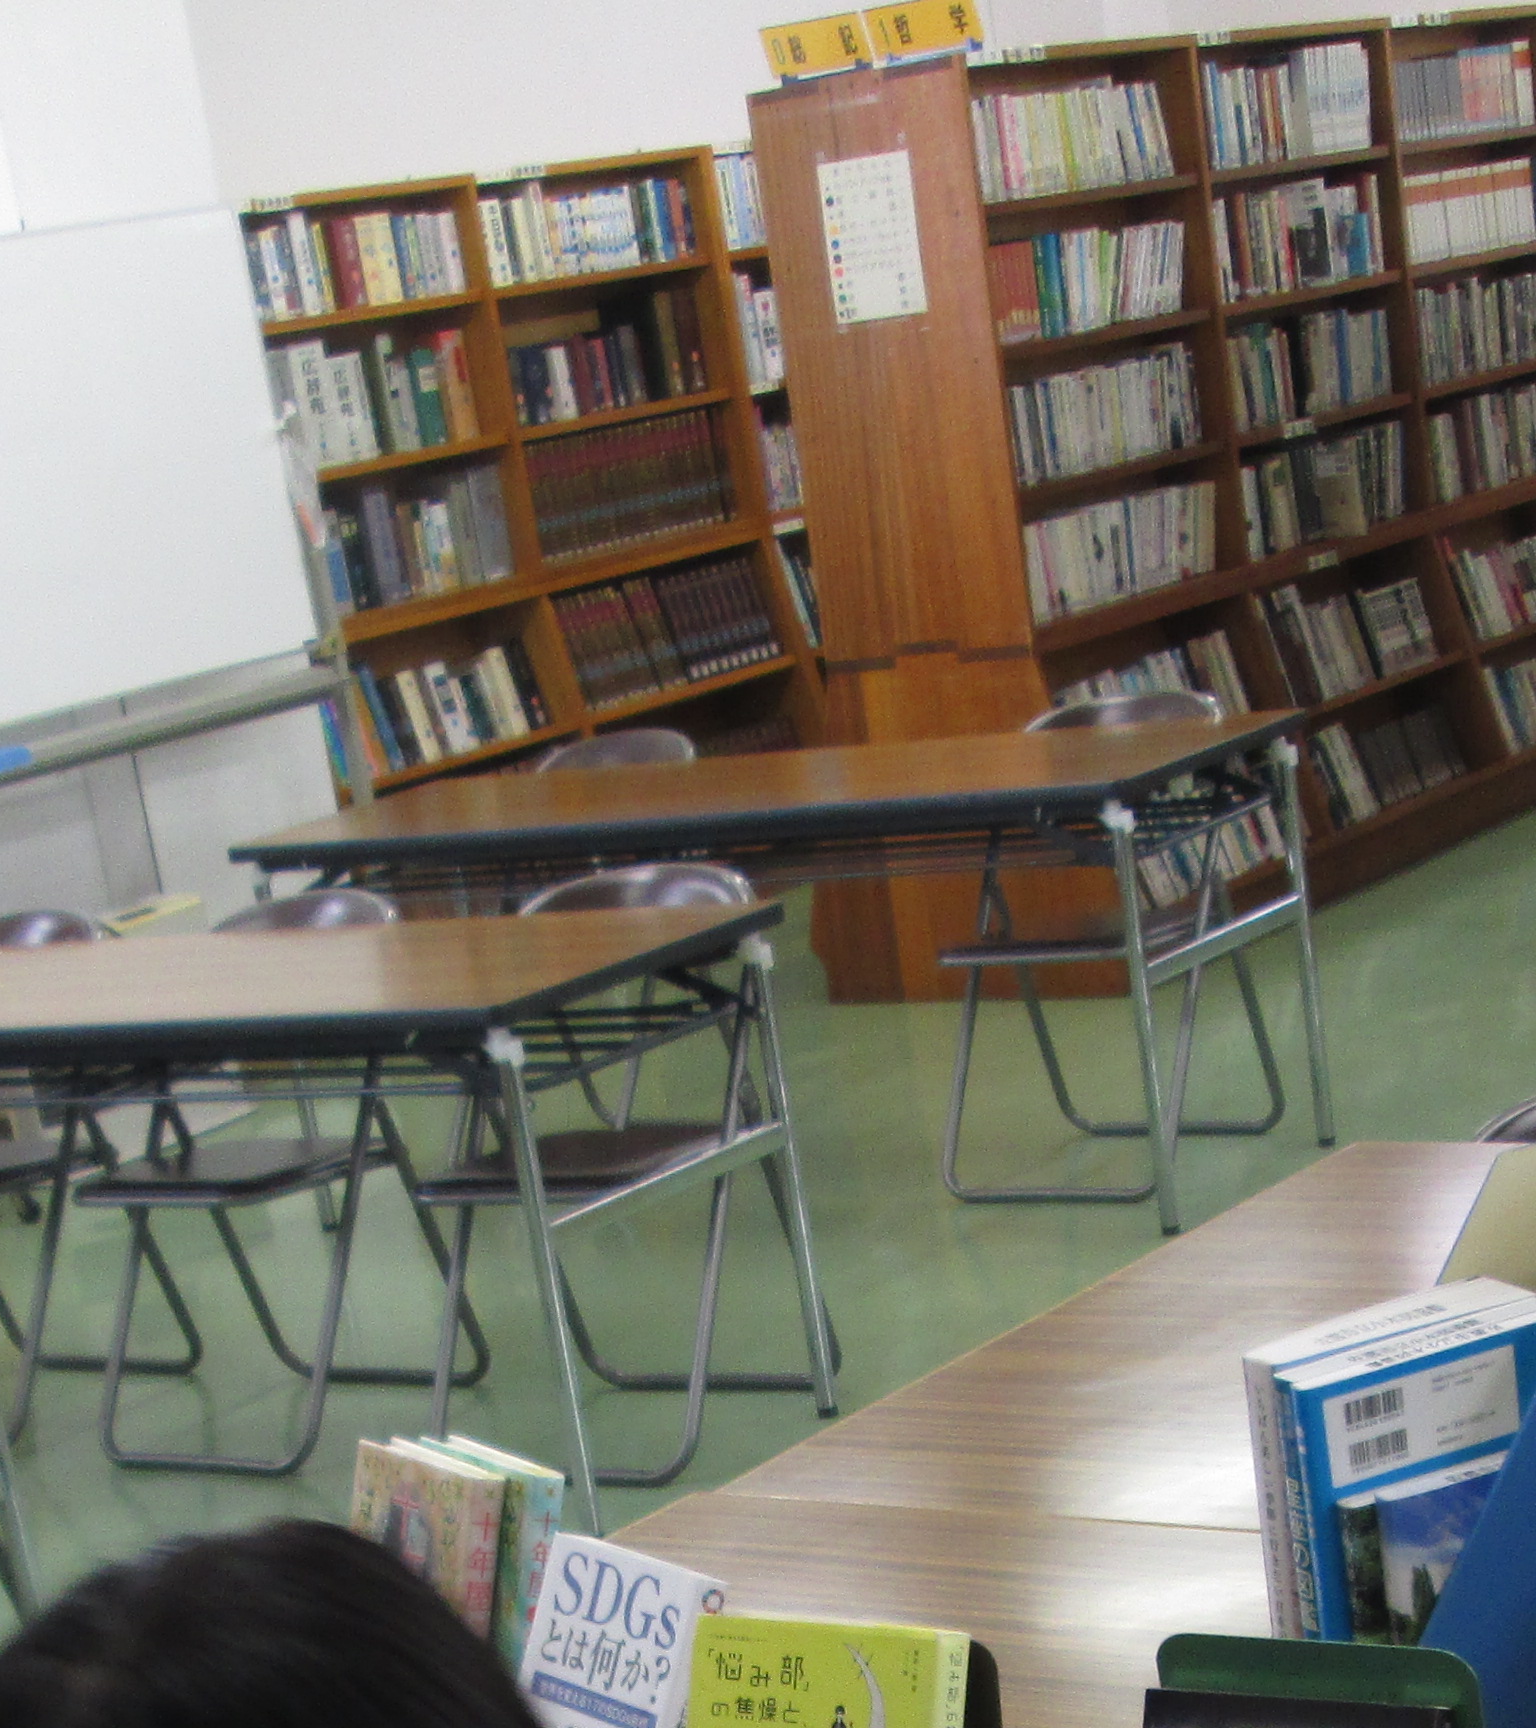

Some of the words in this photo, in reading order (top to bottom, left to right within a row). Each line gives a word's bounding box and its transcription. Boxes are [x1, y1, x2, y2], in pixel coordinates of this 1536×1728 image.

[553, 1551, 682, 1651] SDGs
[541, 1618, 671, 1704] とは何か?
[708, 1648, 809, 1692] 「悩み部」
